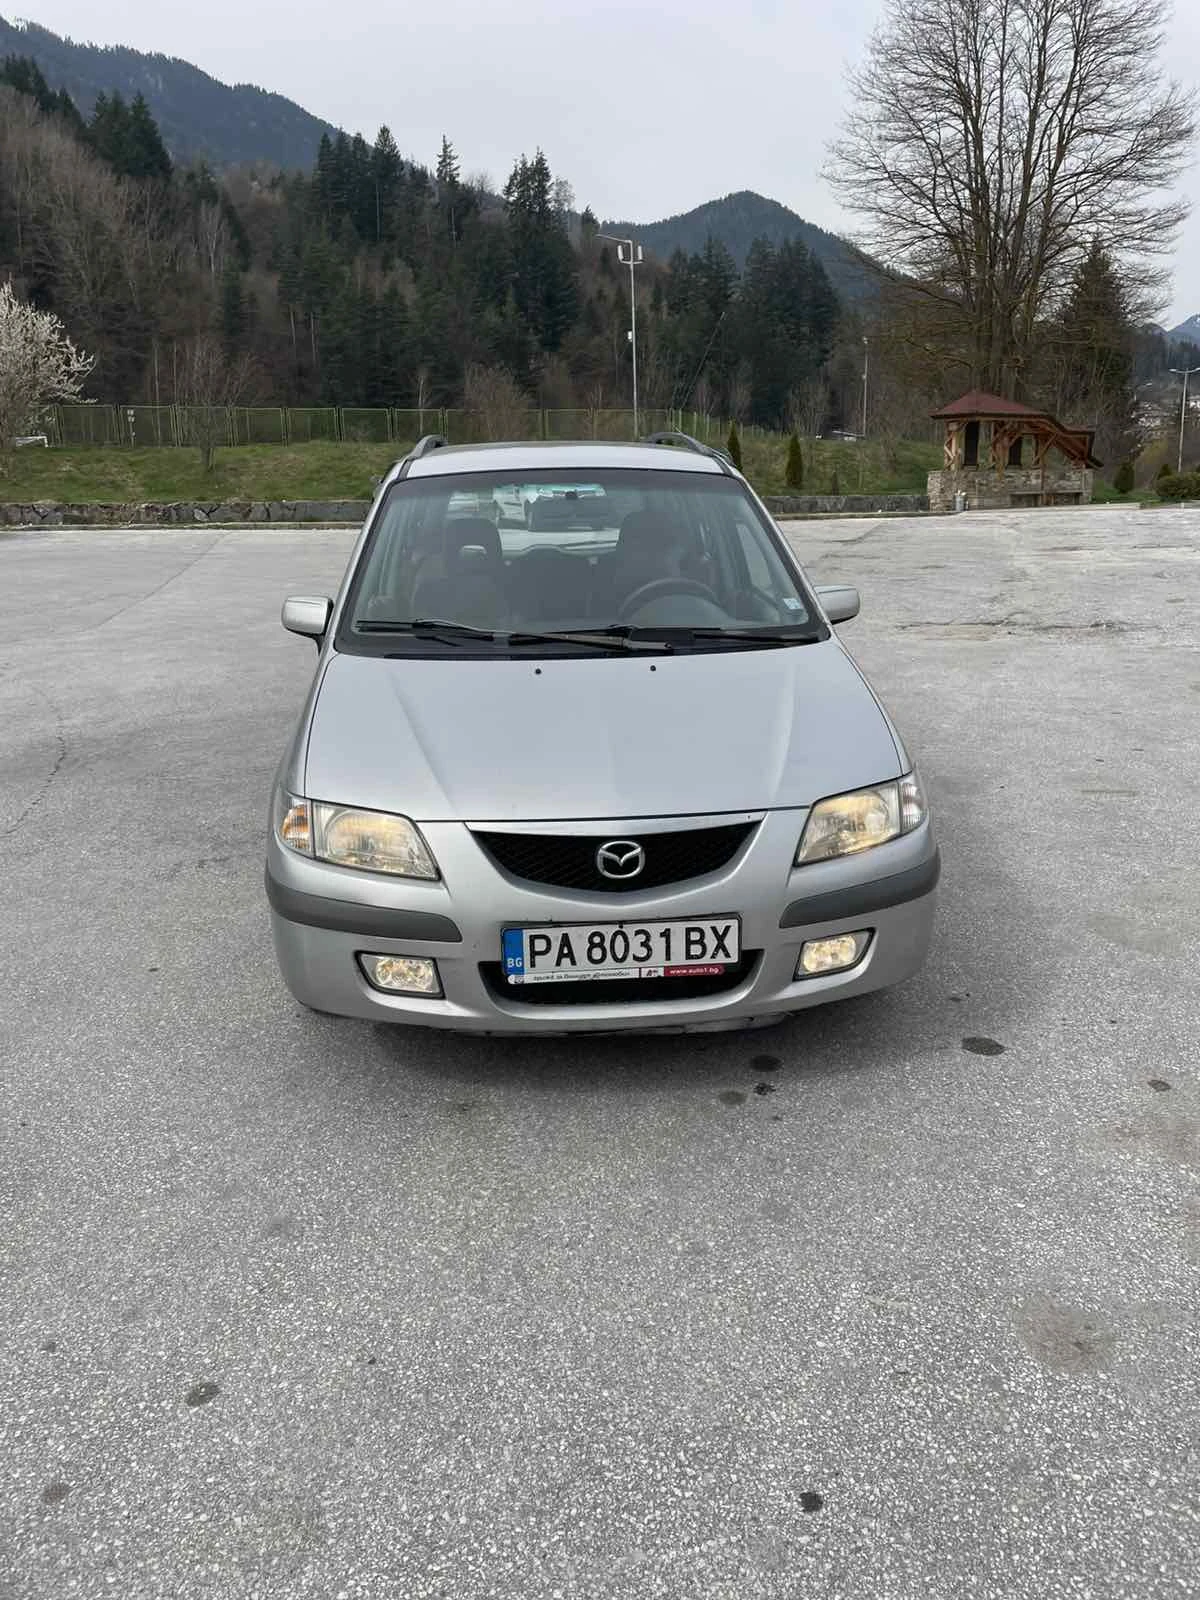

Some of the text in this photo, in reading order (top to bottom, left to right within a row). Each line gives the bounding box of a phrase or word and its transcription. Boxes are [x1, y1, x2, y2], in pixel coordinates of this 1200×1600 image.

[529, 925, 733, 968] PA 8031 BX
[507, 957, 523, 968] BG
